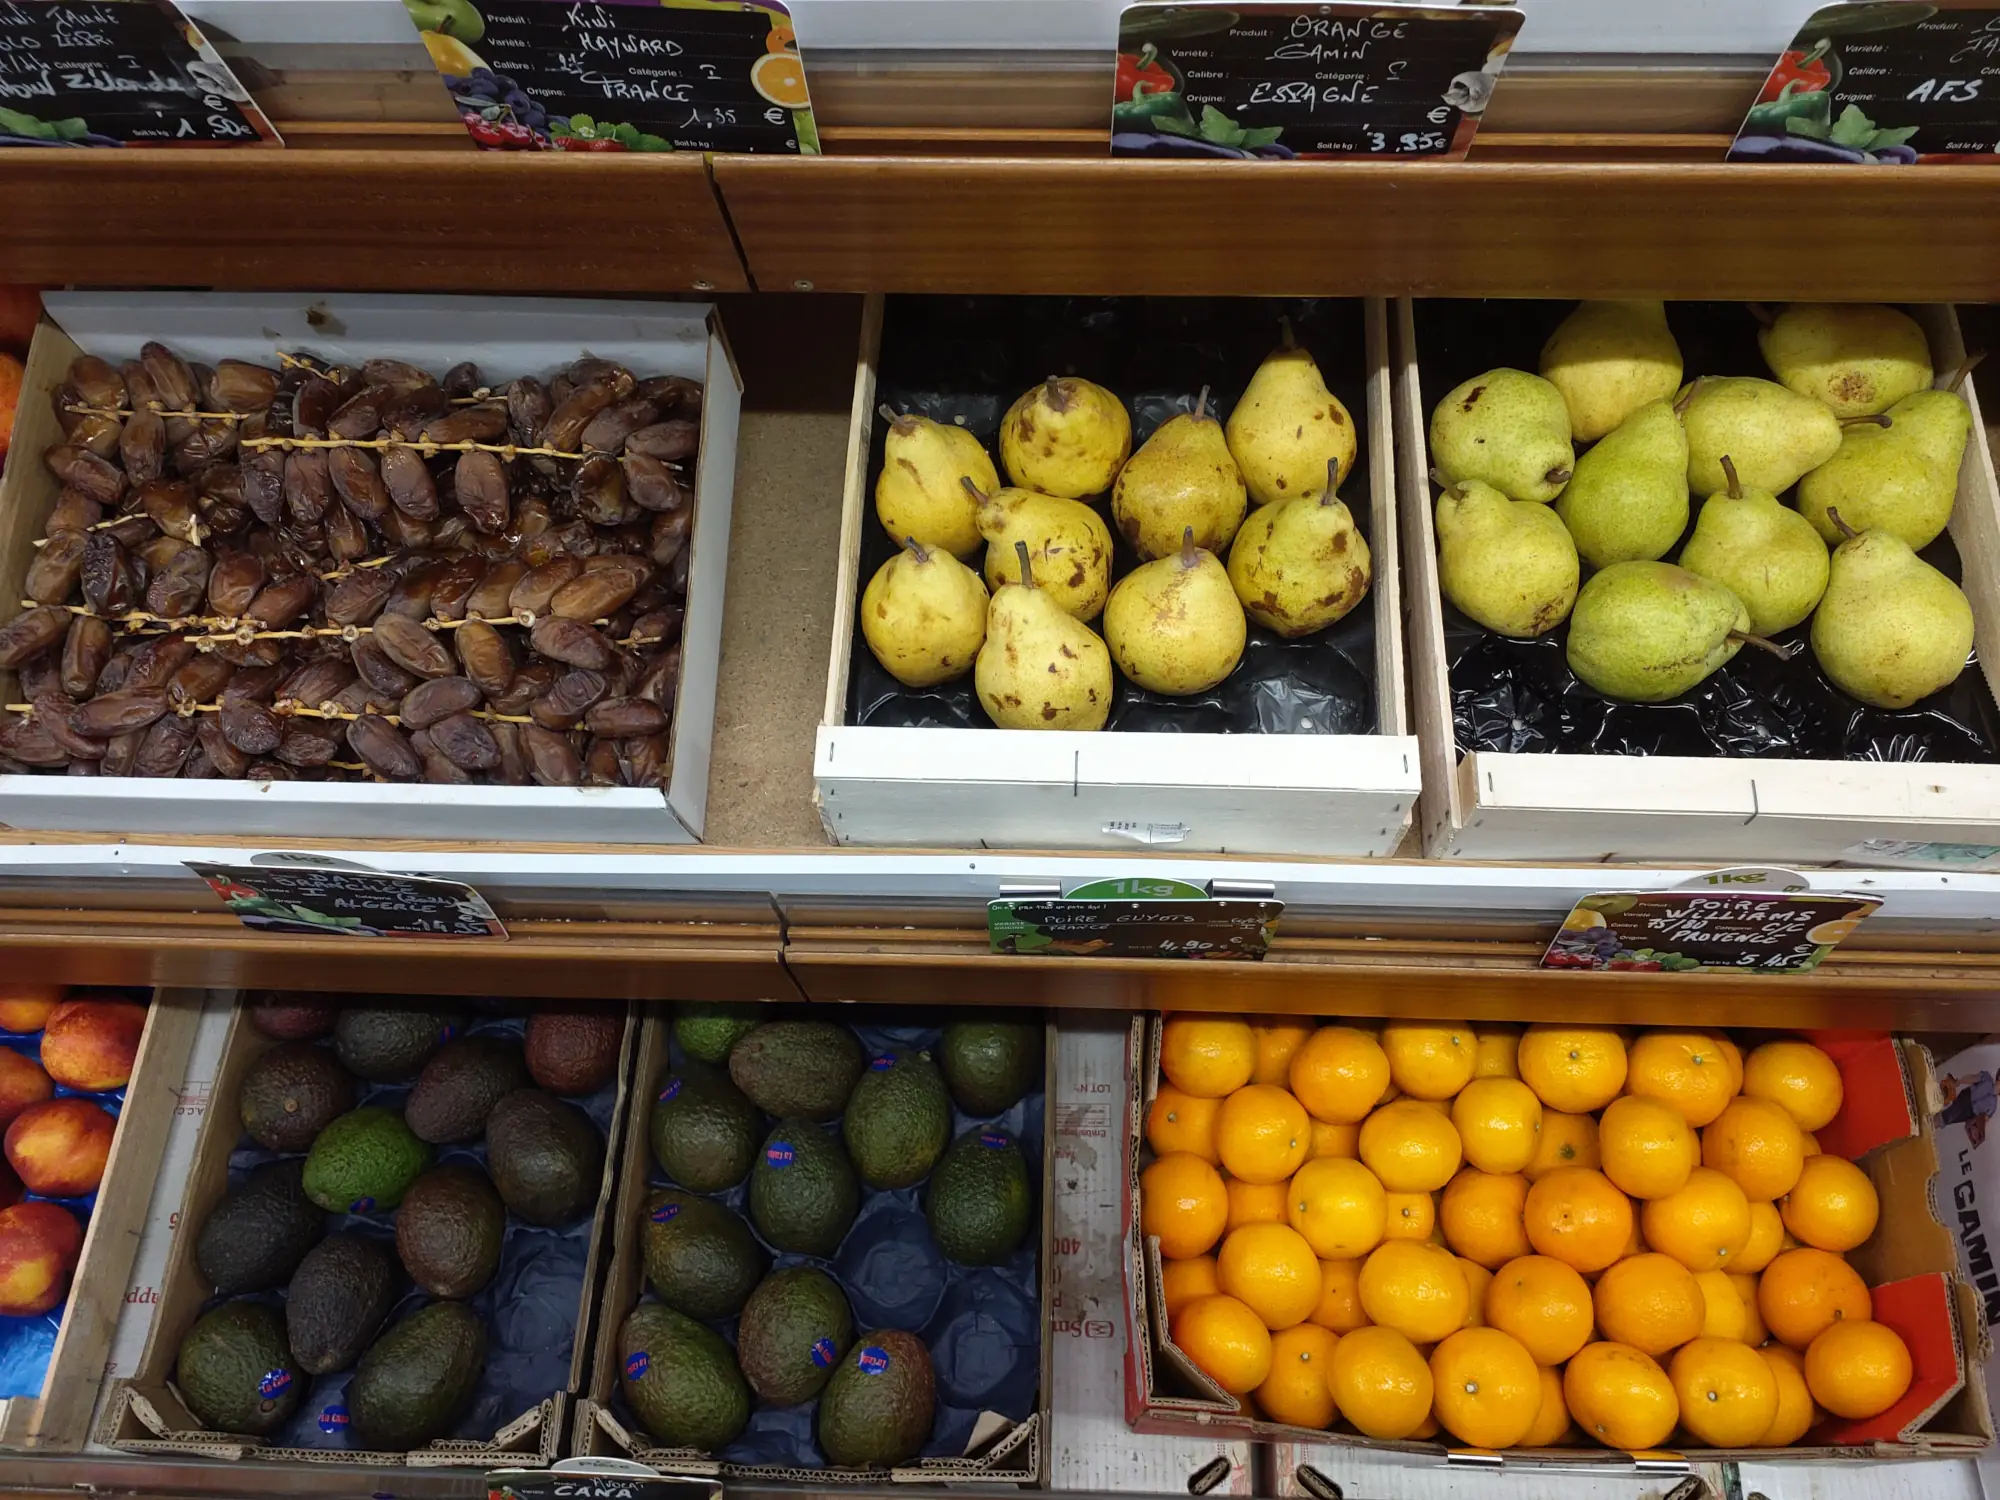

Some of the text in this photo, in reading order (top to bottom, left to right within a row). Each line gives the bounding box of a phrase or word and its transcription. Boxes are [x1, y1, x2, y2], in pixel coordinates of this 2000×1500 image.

[1229, 15, 1409, 41] Produit ORANGE
[1917, 22, 1957, 30] Produit
[579, 32, 684, 58] HAYWARD
[493, 61, 530, 70] Calibre
[628, 67, 678, 77] Catégorie
[1849, 67, 1886, 75] Calibre
[1187, 71, 1224, 79] Calibre
[1315, 72, 1365, 81] Catégorie
[580, 71, 694, 102] FRANCE
[1907, 78, 1984, 103] AFS
[203, 94, 228, 111] €
[1250, 81, 1379, 112] ESPAGNE
[764, 107, 785, 125] €
[1426, 106, 1450, 124] €
[1110, 879, 1176, 897] 1kg
[335, 898, 437, 912] ALGERIE
[1116, 914, 1196, 923] GUYOTS
[1670, 930, 1788, 944] PROVENCE
[1091, 1084, 1111, 1093] LOT
[1957, 1148, 1972, 1176] LE
[1953, 1179, 2000, 1326] GAMIN
[590, 1477, 644, 1491] AVOCAT
[554, 1486, 632, 1499] CANA
